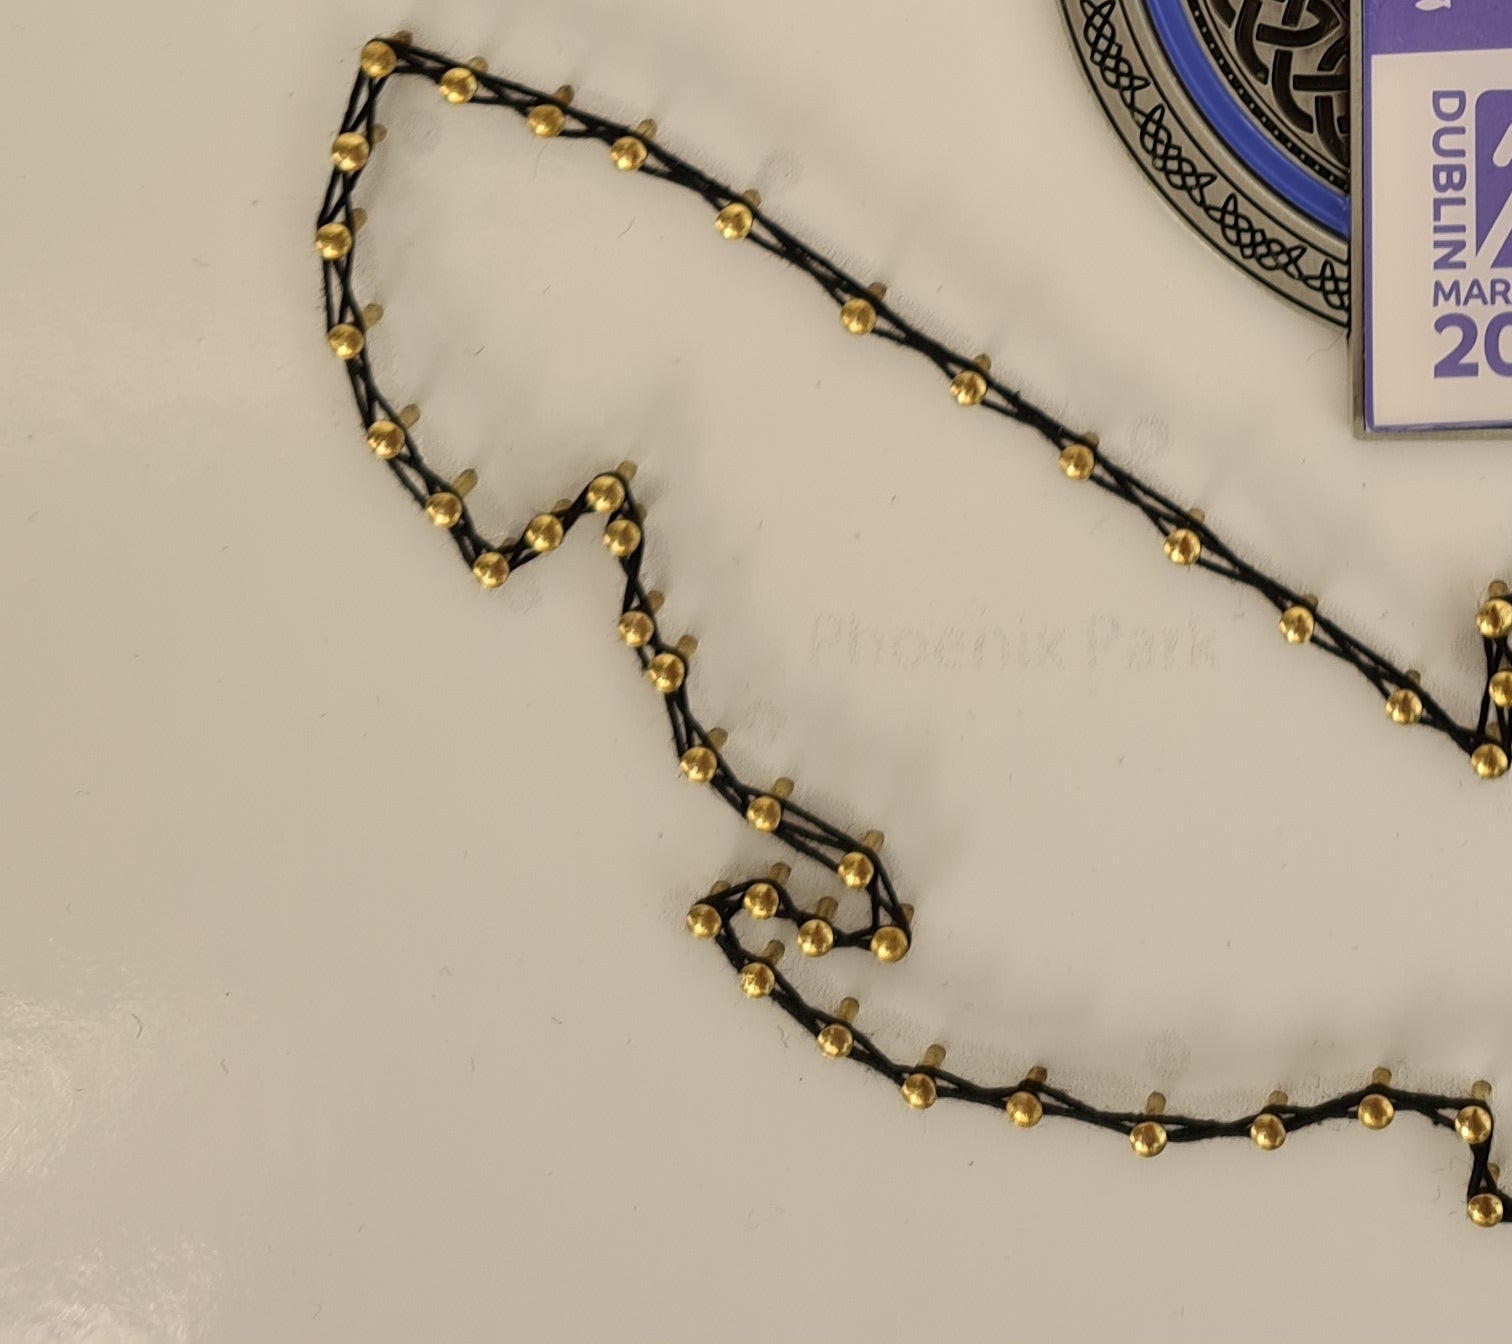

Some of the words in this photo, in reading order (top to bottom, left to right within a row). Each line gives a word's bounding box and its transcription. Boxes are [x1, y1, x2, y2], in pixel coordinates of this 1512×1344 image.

[1431, 89, 1467, 271] DUBLIN
[808, 612, 1067, 671] Phoenix
[1086, 612, 1219, 671] Park
